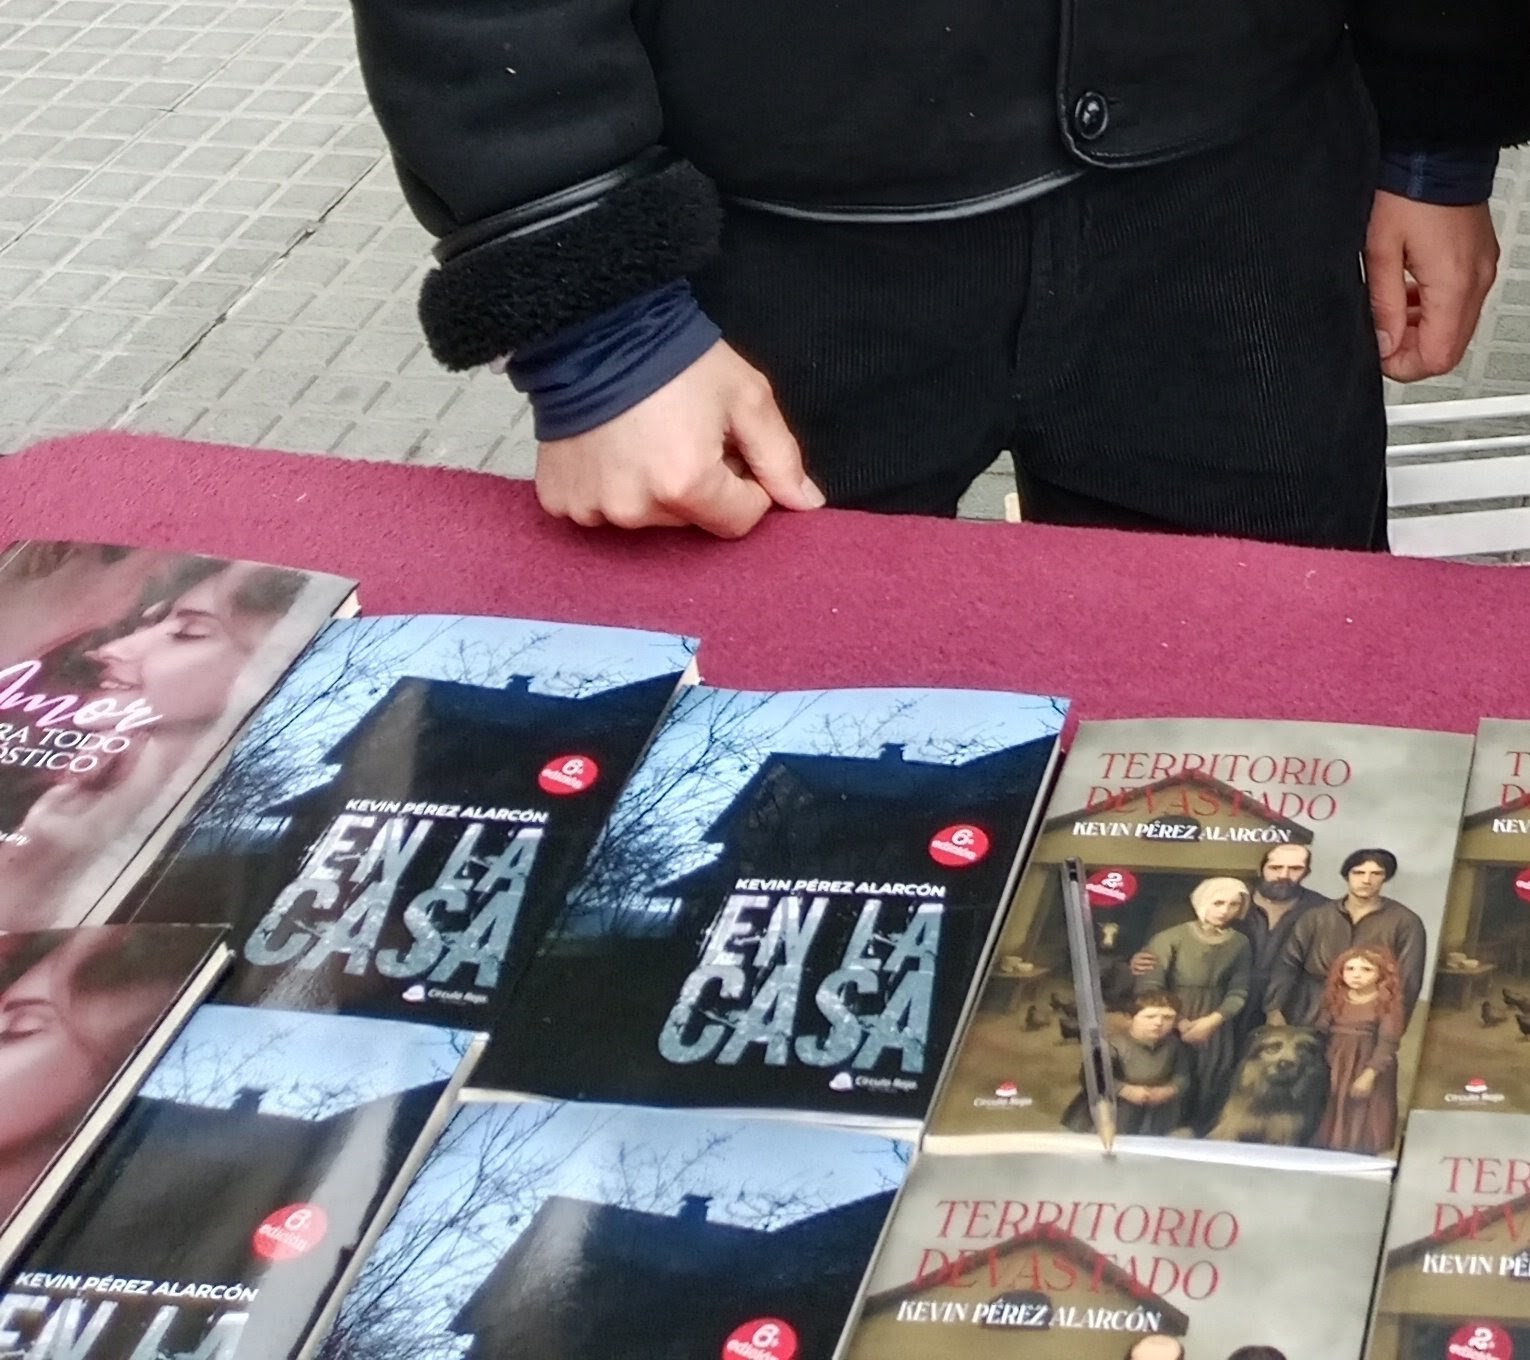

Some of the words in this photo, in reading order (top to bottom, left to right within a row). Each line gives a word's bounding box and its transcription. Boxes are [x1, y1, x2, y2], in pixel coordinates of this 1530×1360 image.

[39, 728, 130, 754] TODO
[1098, 752, 1352, 787] TERRITORIO
[345, 799, 402, 814] KEVIN
[402, 800, 459, 818] PÉREZ
[459, 806, 549, 824] ALARCÓN
[1084, 785, 1338, 821] DEVASTADO
[1073, 821, 1132, 837] KEVIN
[1134, 820, 1199, 840] PÉREZ
[1198, 825, 1292, 843] ALARCÓN
[300, 813, 433, 884] EN
[434, 823, 544, 893] LA
[735, 878, 792, 892] KEVIN
[793, 878, 855, 894] PÉREZ
[855, 881, 946, 898] ALARCÓN
[244, 880, 526, 989] CASA
[702, 895, 830, 967] EN
[841, 899, 945, 972] LA
[658, 964, 936, 1074] CASA
[936, 1200, 1240, 1250] TERRITORIO
[913, 1248, 1220, 1301] DEVASTADO
[1422, 1252, 1493, 1275] KEVIN
[15, 1271, 82, 1290] KEVIN
[83, 1275, 154, 1294] PÉREZ
[154, 1281, 260, 1302] ALARCÓN
[896, 1300, 968, 1323] KEVIN
[971, 1297, 1048, 1327] PÉREZ
[1049, 1305, 1162, 1332] ALARCÓN
[129, 1305, 250, 1360] LA
